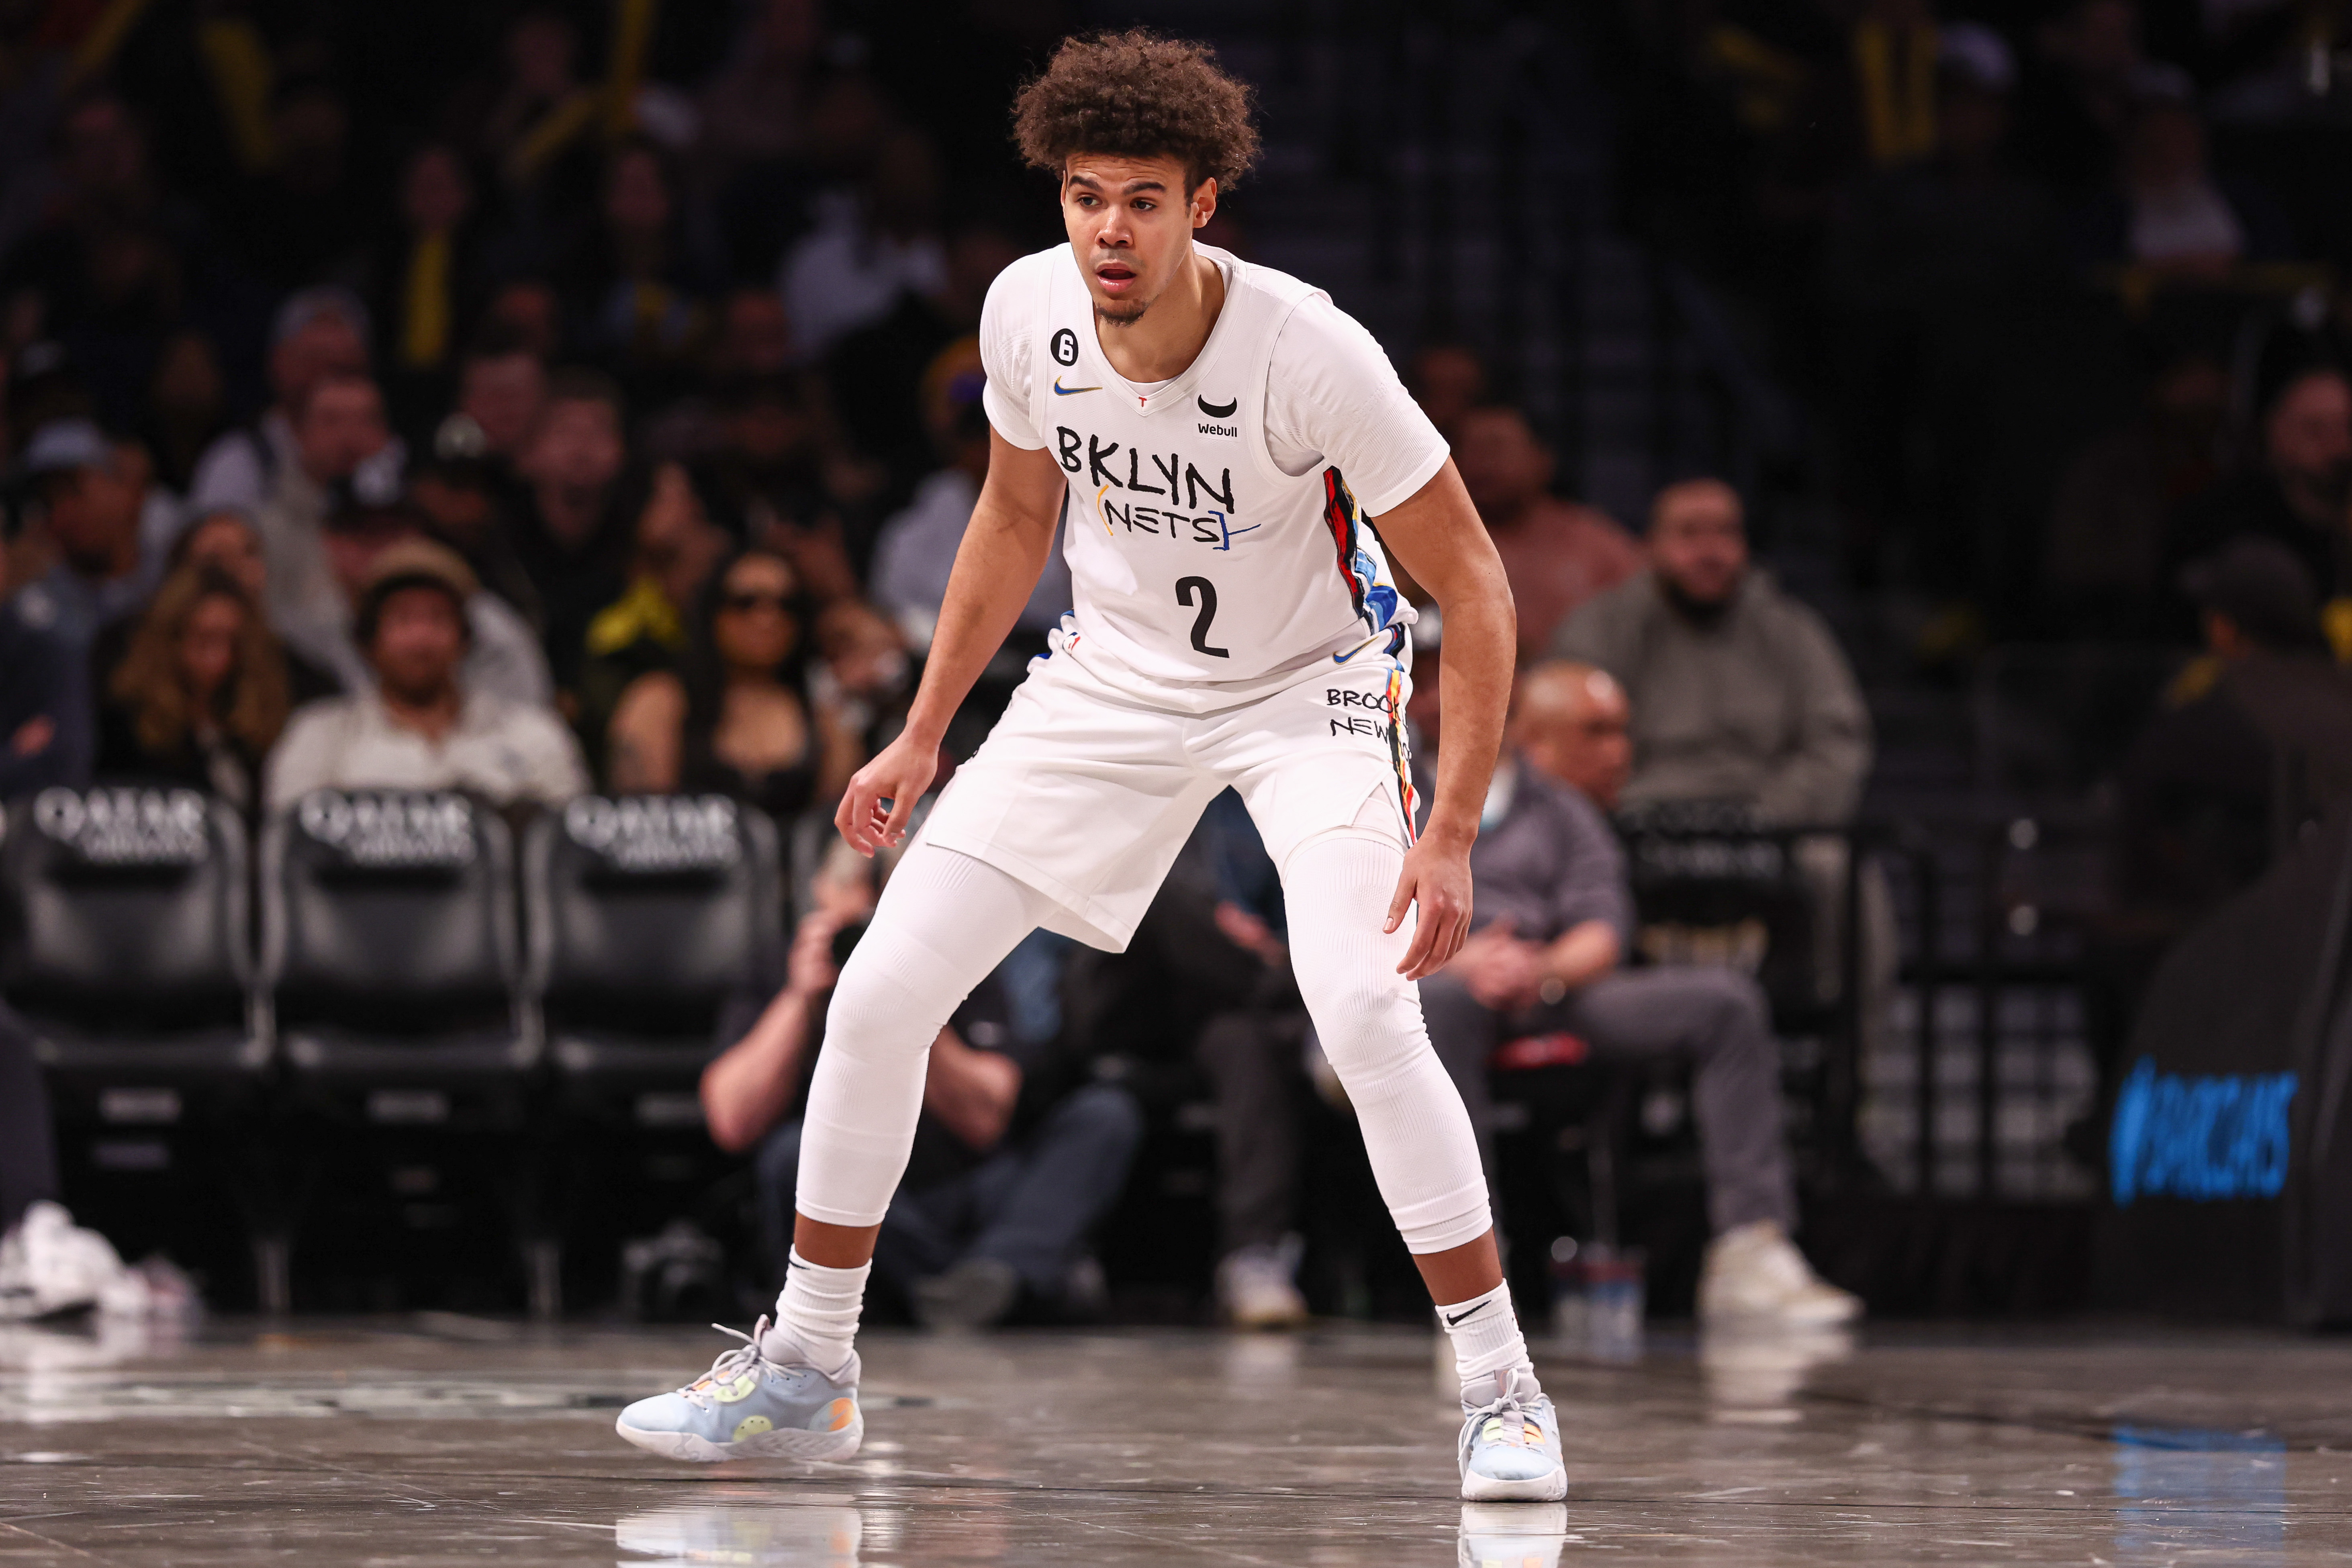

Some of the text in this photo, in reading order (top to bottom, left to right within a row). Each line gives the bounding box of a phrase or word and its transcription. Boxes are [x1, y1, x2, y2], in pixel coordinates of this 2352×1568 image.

[1058, 333, 1074, 362] 6
[1198, 423, 1237, 437] Webull
[1056, 426, 1234, 514] BKLYN
[1175, 576, 1230, 658] 2
[1330, 716, 1389, 744] NEW
